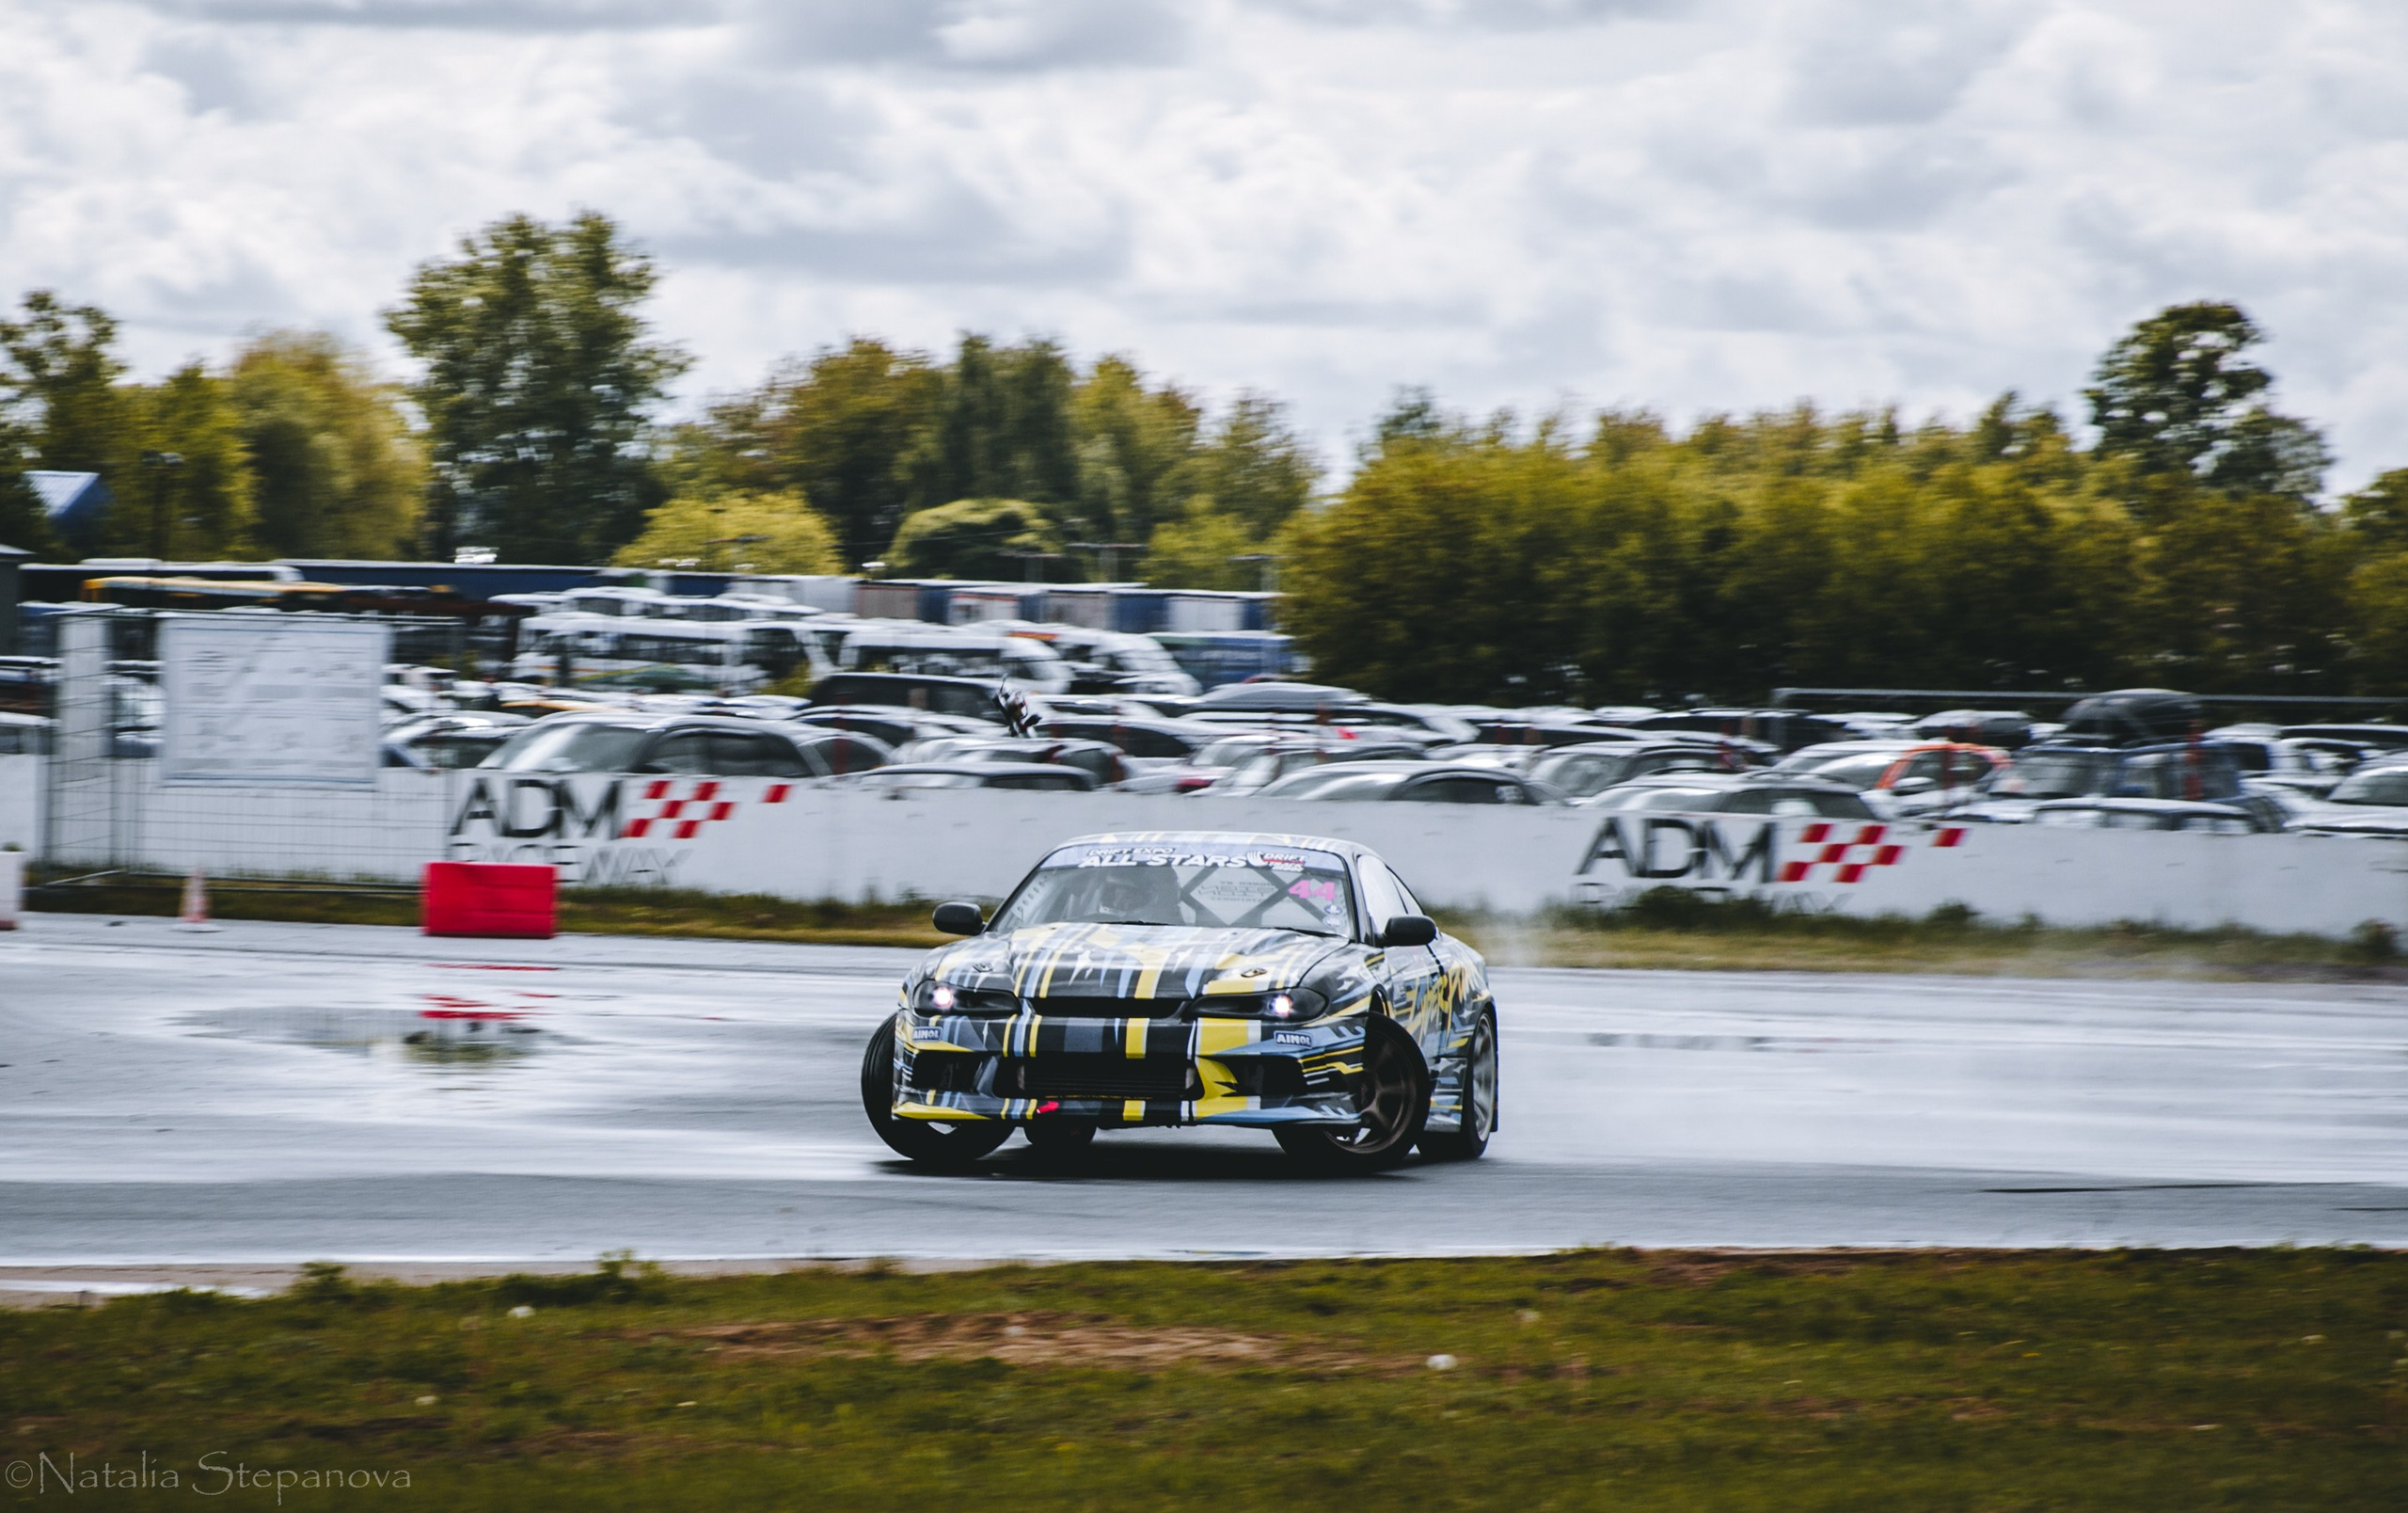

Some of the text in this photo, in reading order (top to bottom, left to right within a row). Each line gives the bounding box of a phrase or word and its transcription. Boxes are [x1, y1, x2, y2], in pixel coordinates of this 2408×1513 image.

[449, 778, 626, 840] ADM
[1088, 848, 1131, 856] DRIFT
[1262, 852, 1307, 861] DRIFT
[1572, 816, 1781, 884] ADM
[1078, 853, 1246, 868] ALL STARS
[1288, 880, 1336, 900] 44
[912, 1029, 939, 1040] AIMOL
[1276, 1033, 1311, 1044] AIMOL
